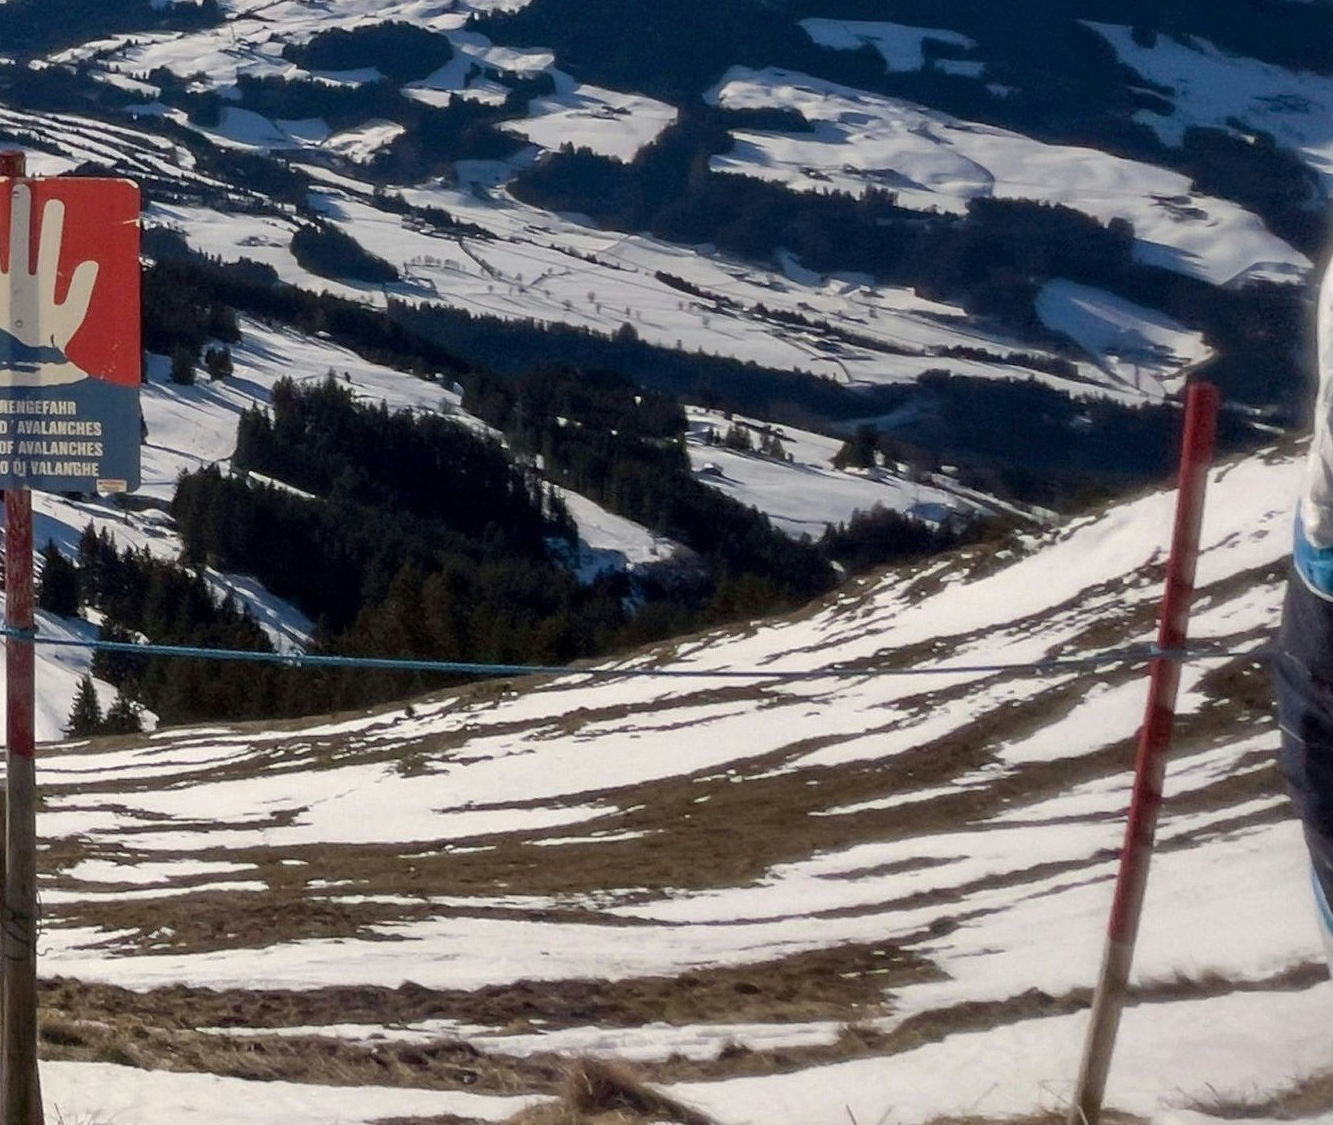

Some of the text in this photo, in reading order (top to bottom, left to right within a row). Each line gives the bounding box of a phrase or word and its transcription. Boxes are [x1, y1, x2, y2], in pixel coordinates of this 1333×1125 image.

[17, 420, 102, 436] AVALANCHES
[18, 441, 104, 457] AVALANCHES
[30, 461, 100, 477] VALANGHE
